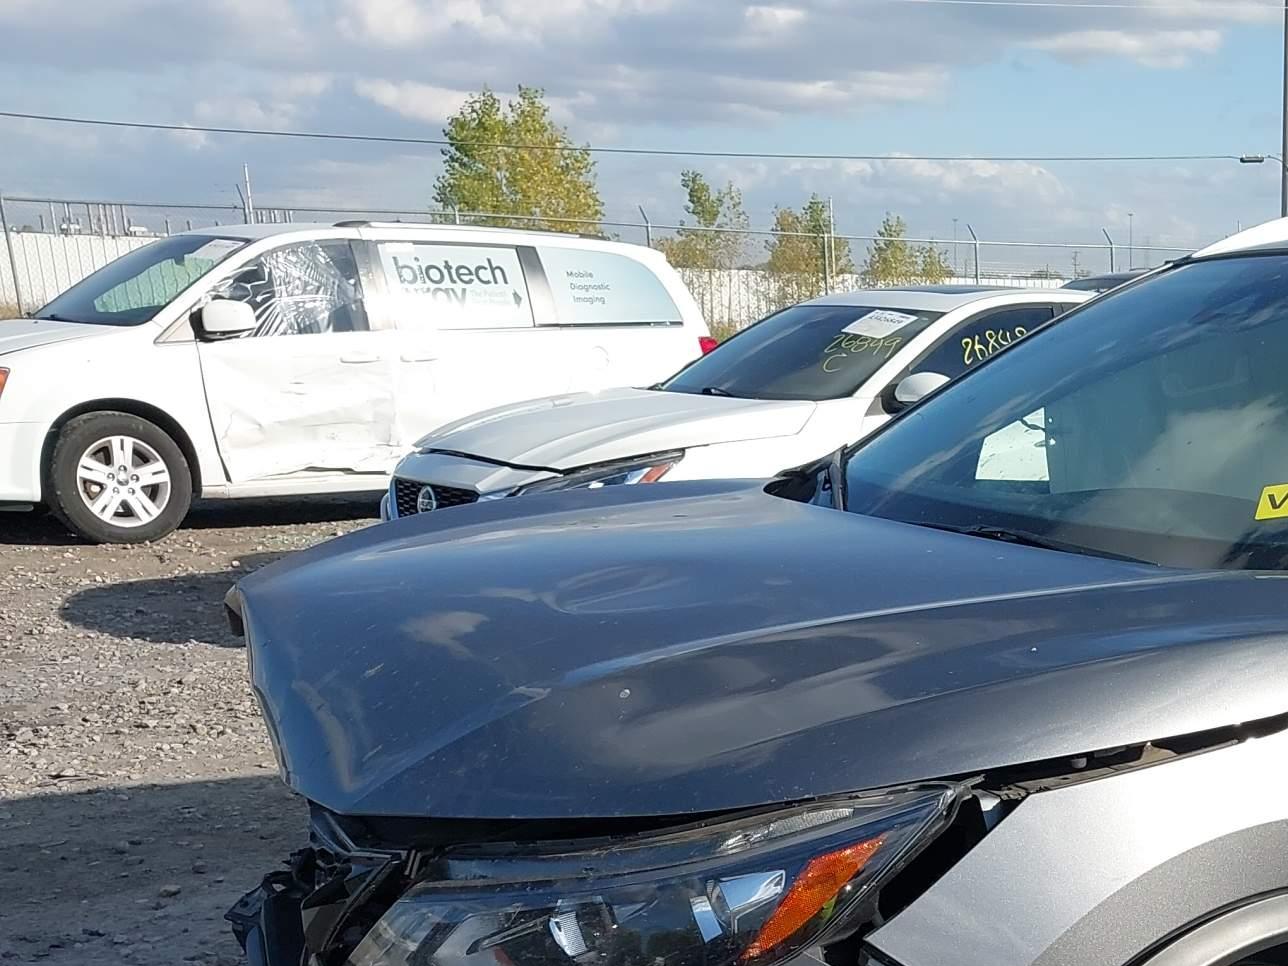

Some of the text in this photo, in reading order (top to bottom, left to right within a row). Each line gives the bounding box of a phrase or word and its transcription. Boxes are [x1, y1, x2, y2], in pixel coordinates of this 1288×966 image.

[392, 256, 508, 285] biotech
[566, 271, 594, 279] Mobile
[569, 282, 611, 293] Diagnostic
[573, 295, 606, 305] Imaging
[824, 334, 902, 359] 26849
[823, 353, 848, 373] C
